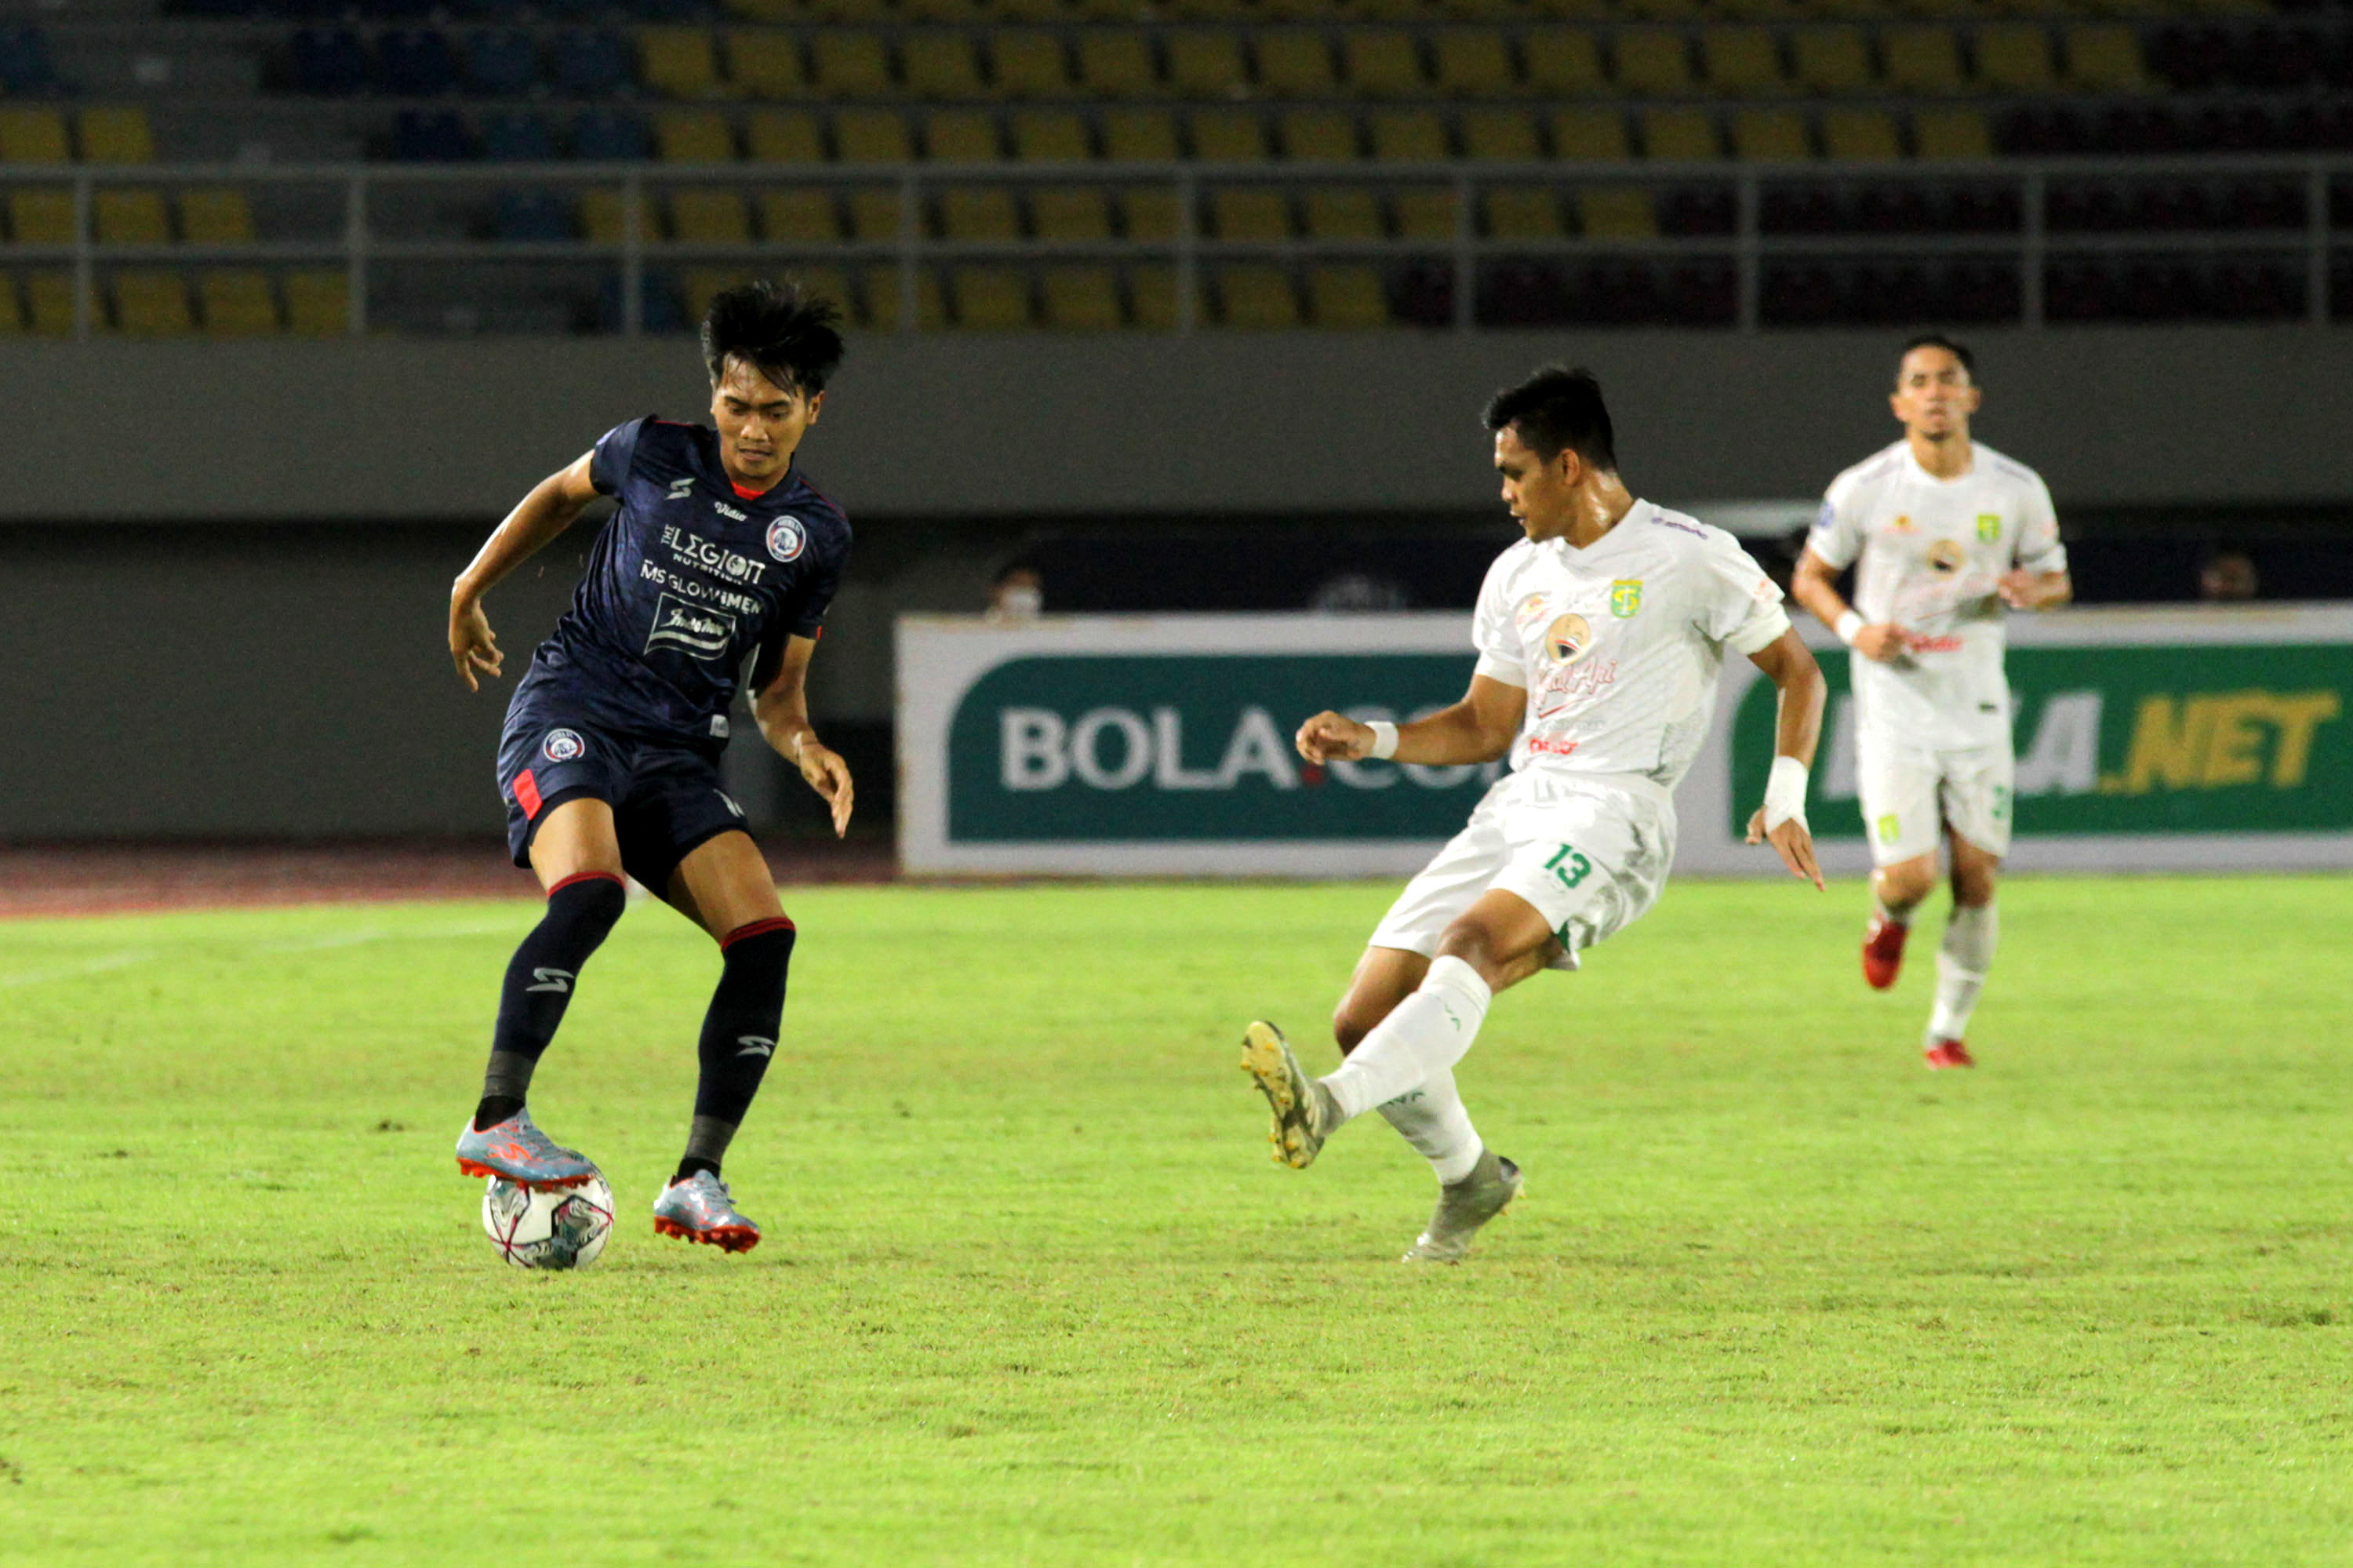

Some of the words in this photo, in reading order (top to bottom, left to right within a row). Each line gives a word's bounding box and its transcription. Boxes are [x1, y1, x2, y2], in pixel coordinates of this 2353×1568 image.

[714, 500, 747, 522] Vidio
[660, 524, 675, 545] THE
[640, 560, 667, 584] MS
[667, 574, 721, 601] GLOW
[1000, 704, 1504, 791] BOLA.C
[1544, 842, 1592, 890] 13
